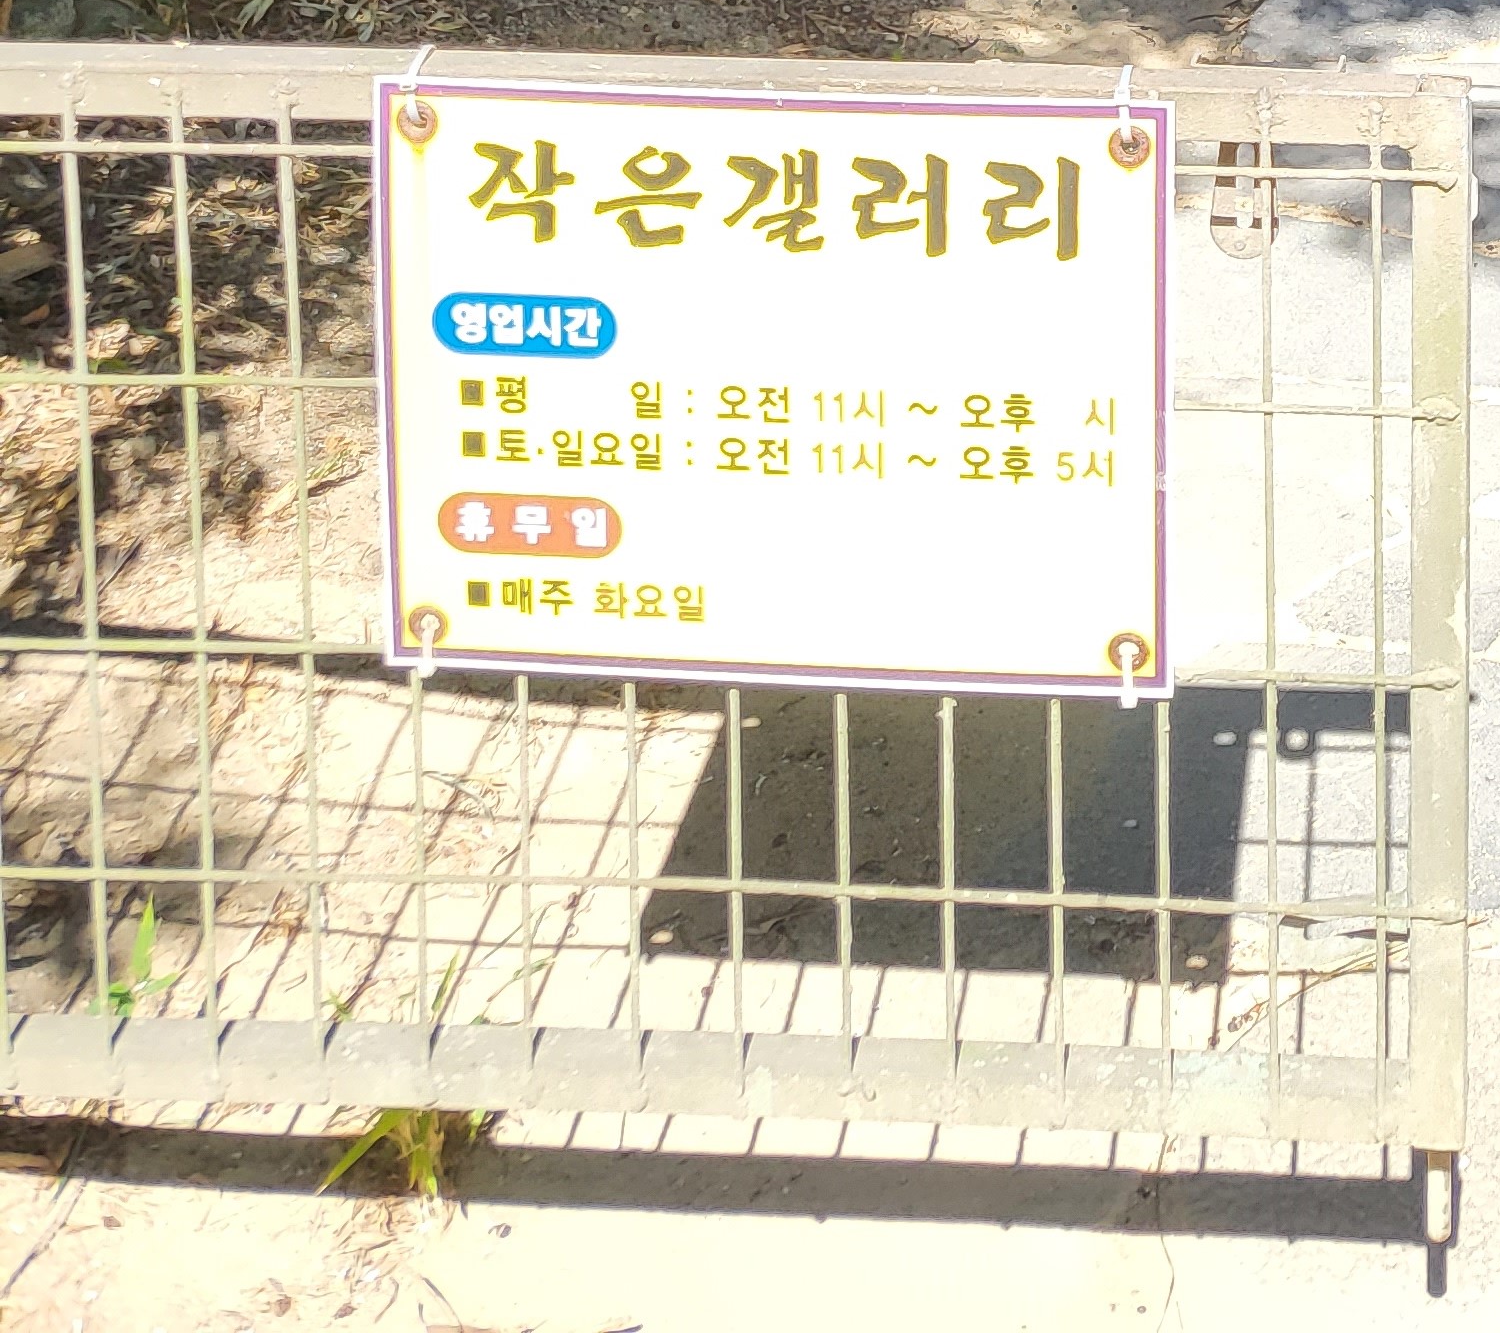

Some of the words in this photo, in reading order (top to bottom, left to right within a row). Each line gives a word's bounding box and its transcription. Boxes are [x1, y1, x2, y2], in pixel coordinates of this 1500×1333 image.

[467, 138, 1082, 263] 작은갤러리
[450, 302, 602, 348] 영업시간
[717, 385, 790, 424] 오전
[813, 390, 885, 428] 11시
[960, 393, 1035, 433] 오후
[1085, 397, 1114, 436] 시
[716, 437, 789, 475] 오전
[812, 442, 883, 479] 11시
[959, 445, 1034, 485] 오후
[502, 578, 575, 616] 매주
[594, 582, 704, 622] 화요일
